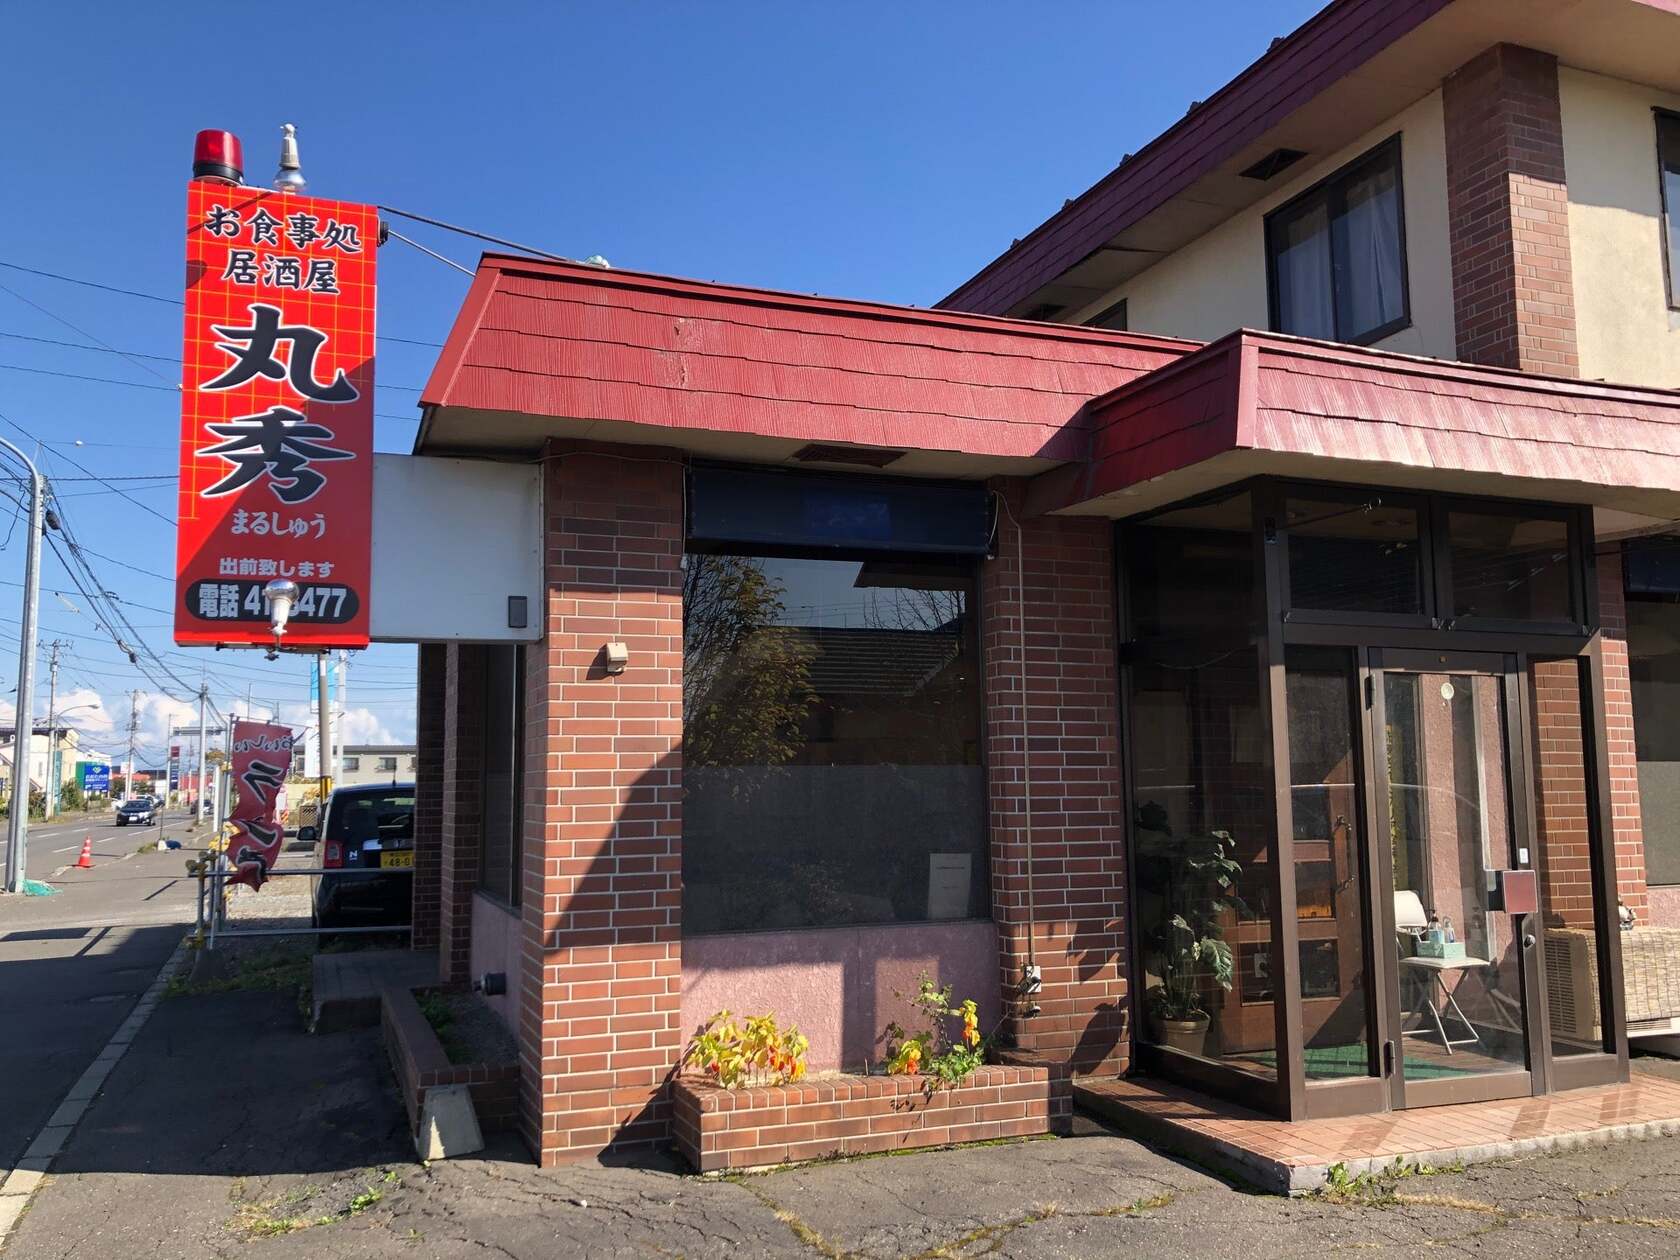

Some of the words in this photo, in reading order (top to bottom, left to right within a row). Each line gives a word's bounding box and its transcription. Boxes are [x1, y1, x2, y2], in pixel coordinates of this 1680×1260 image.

[204, 204, 363, 253] お食事処
[221, 248, 341, 296] 居酒屋
[194, 302, 360, 504] 丸秀
[231, 508, 327, 539] まるしゅう
[219, 557, 335, 578] 出前致します
